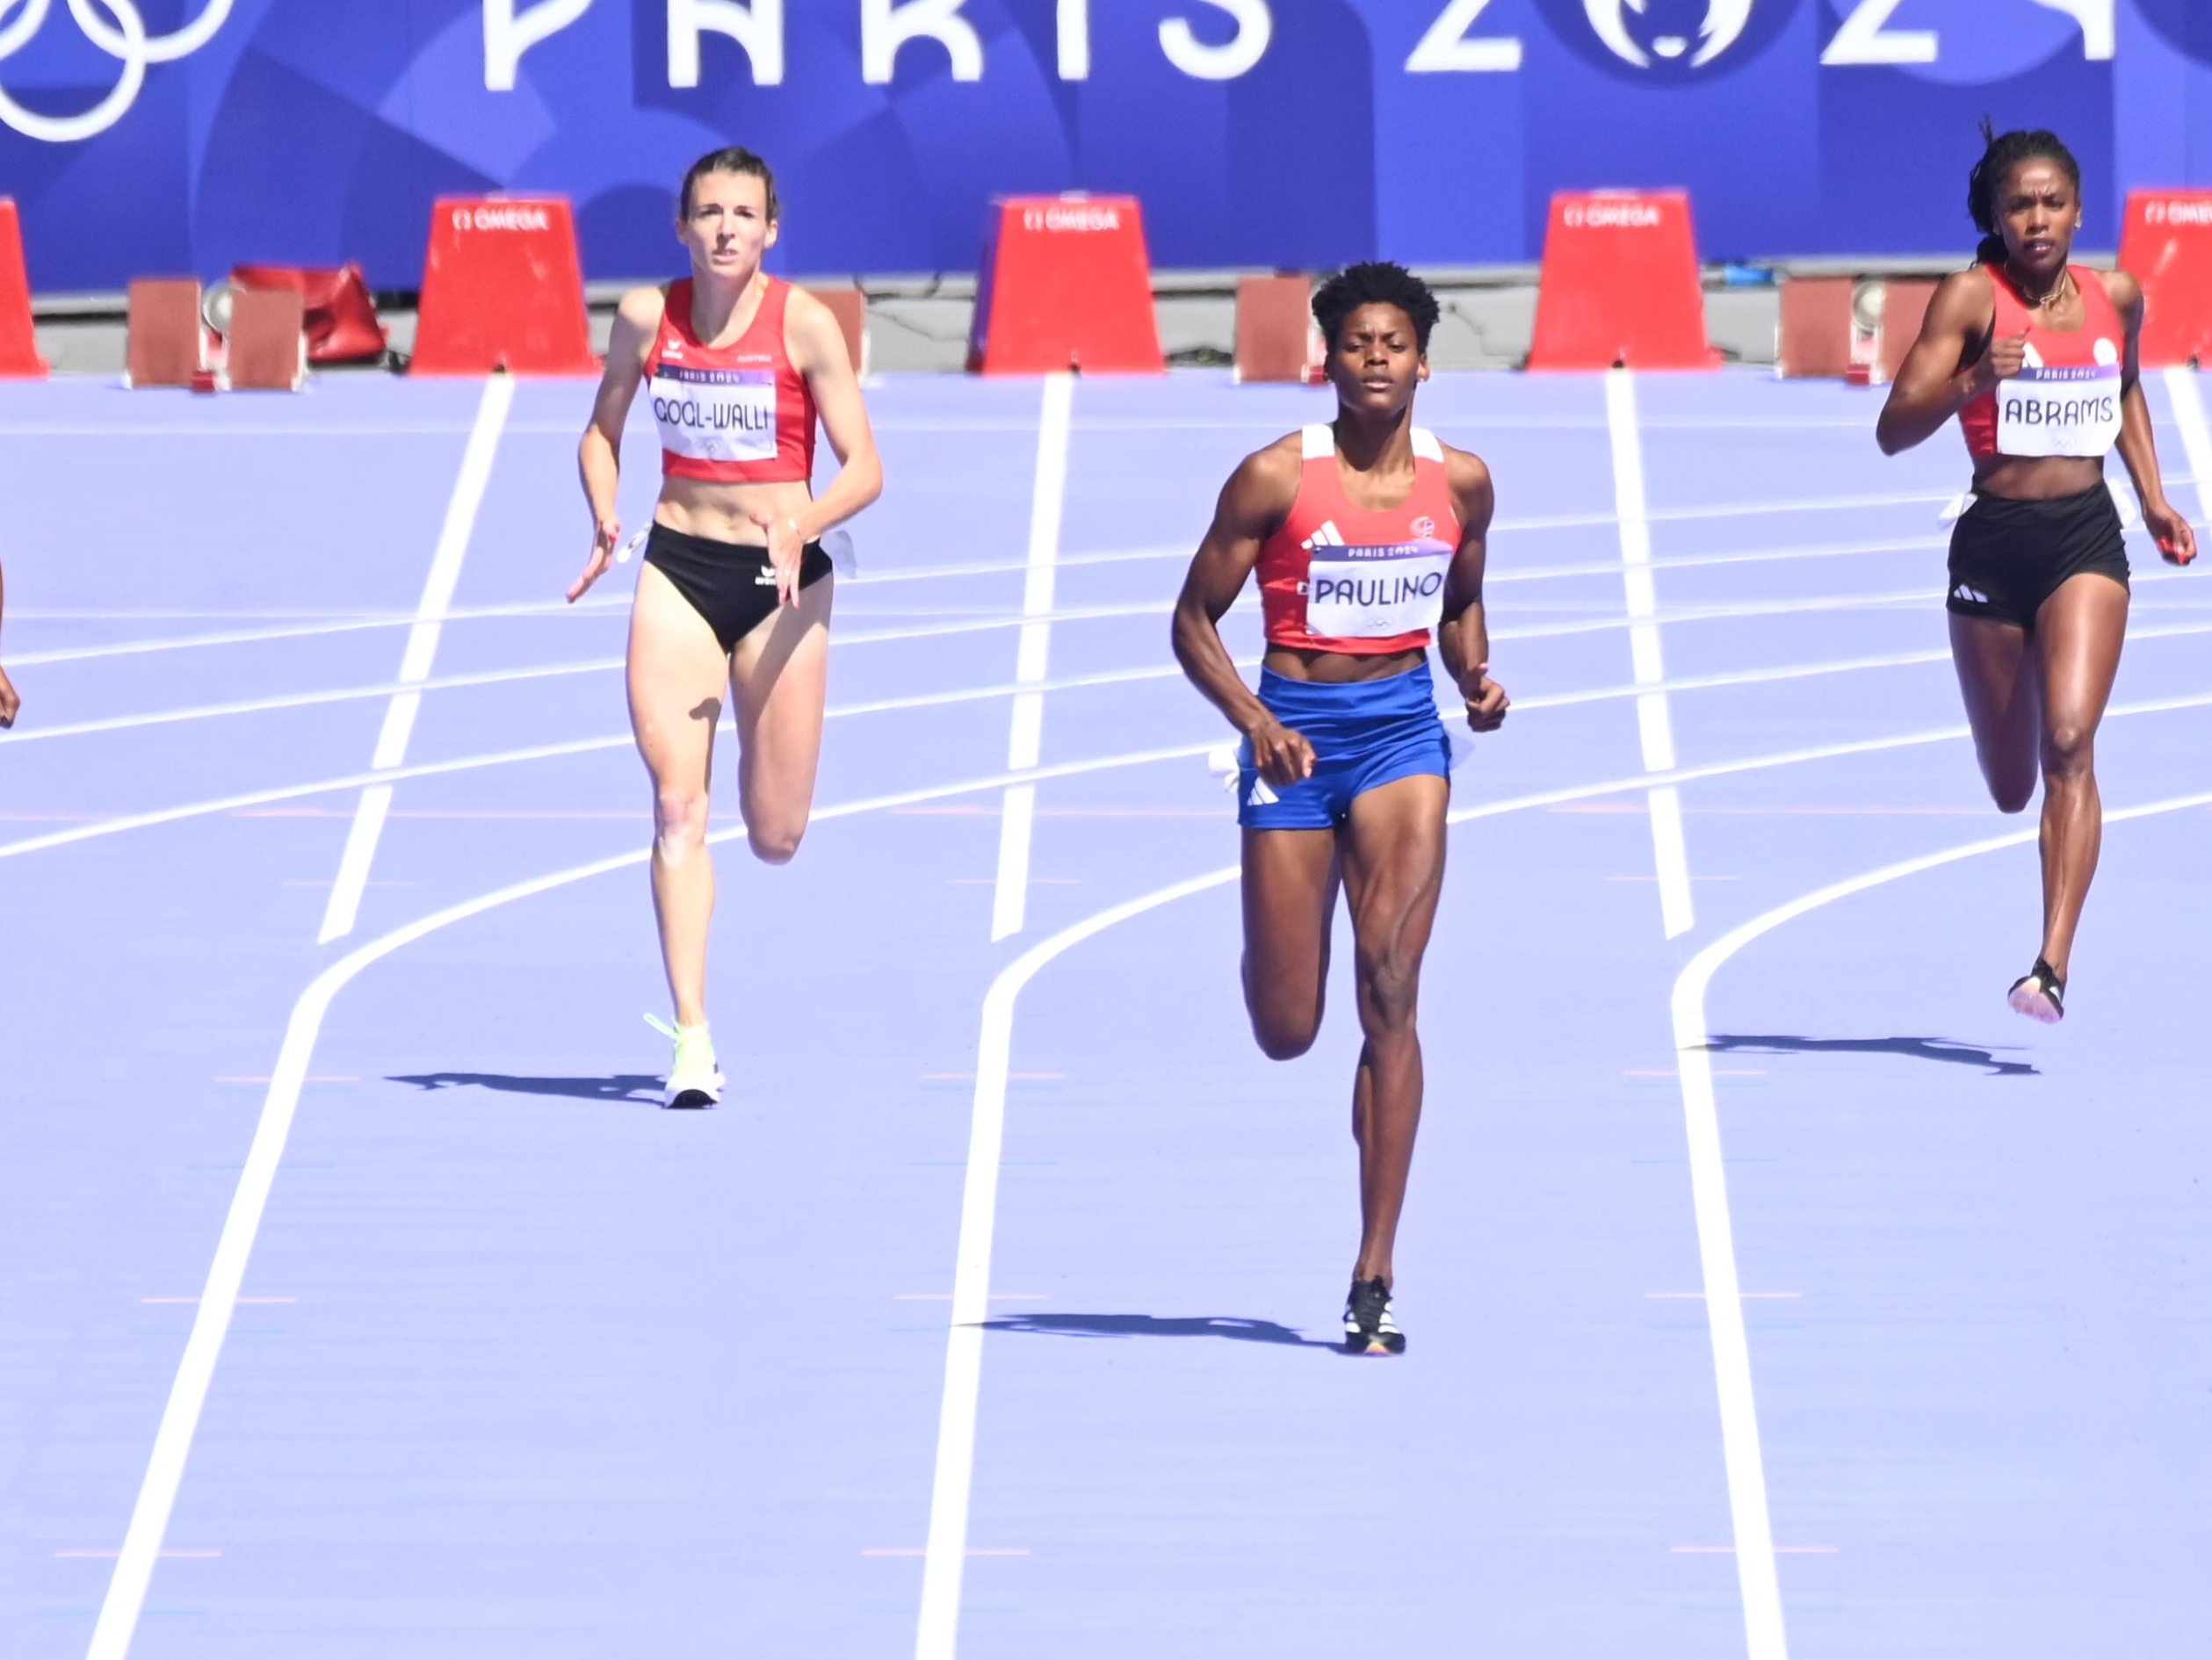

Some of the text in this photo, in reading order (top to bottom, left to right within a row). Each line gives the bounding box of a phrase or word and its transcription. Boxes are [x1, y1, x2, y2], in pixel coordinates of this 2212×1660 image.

[2167, 201, 2212, 224] OME
[654, 397, 769, 431] GOGL-WALLI
[2005, 396, 2114, 427] ABRAMS
[1348, 547, 1385, 559] PARIS
[1315, 572, 1442, 606] PAULINO
